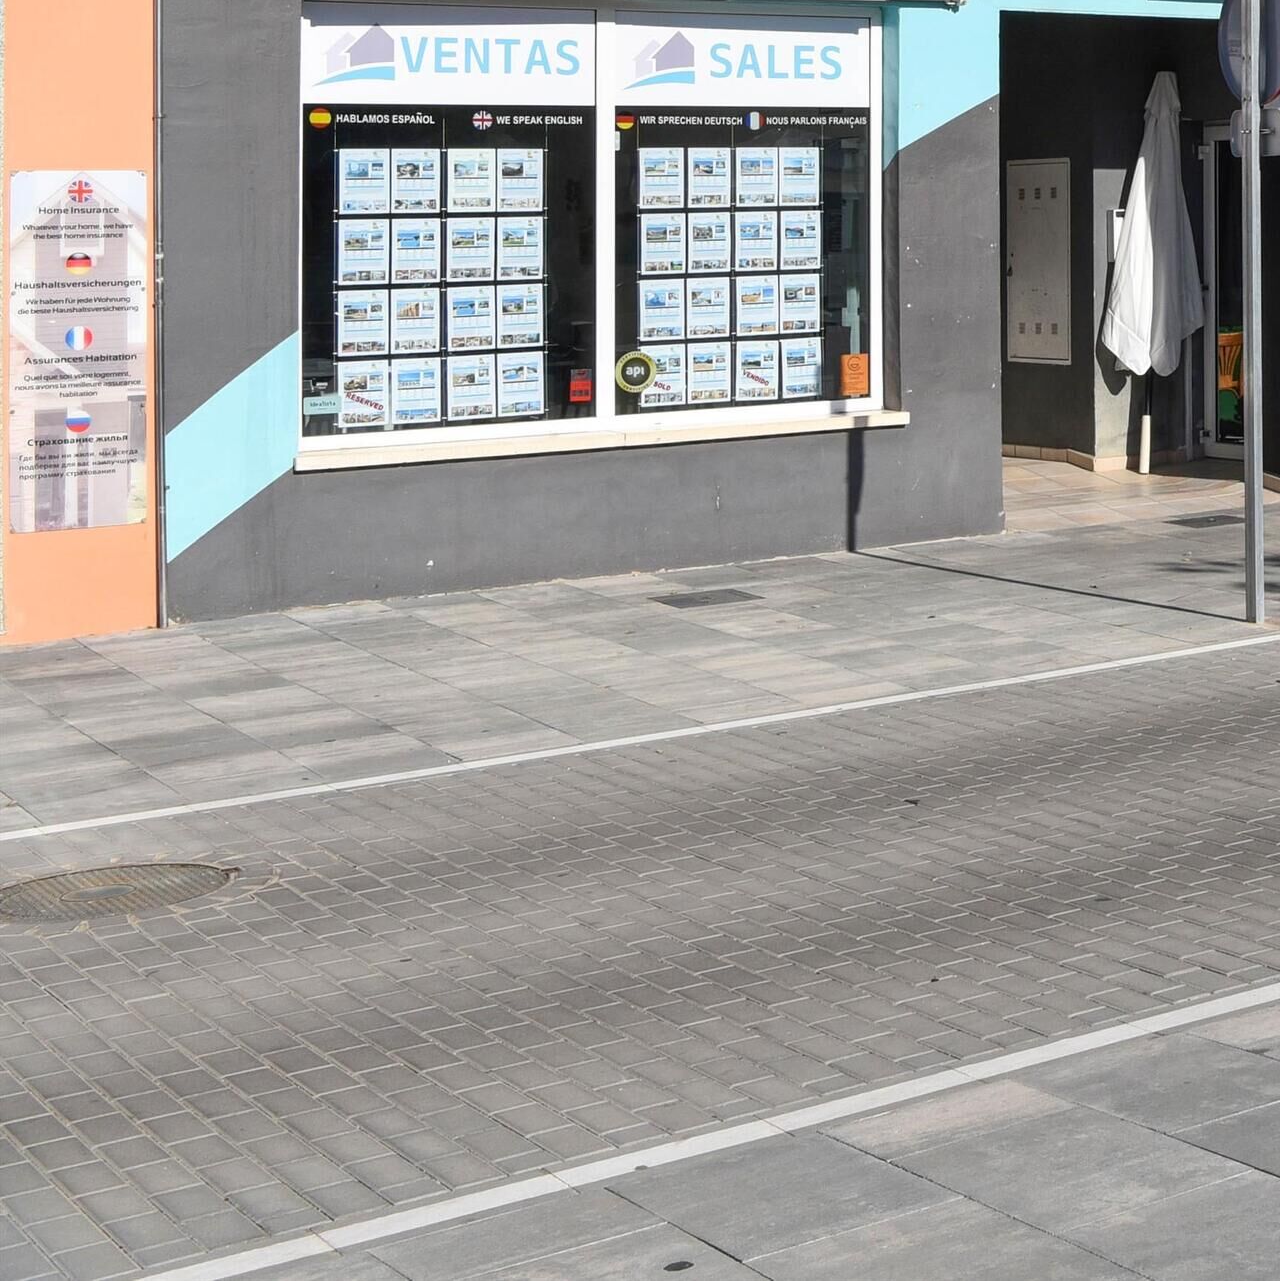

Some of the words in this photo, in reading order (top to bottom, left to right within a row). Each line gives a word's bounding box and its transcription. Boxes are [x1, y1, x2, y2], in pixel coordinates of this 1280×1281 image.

[400, 35, 581, 76] VENTAS
[709, 42, 844, 81] SALES
[336, 114, 390, 123] HABLAMOS
[392, 112, 435, 125] ESPAÑOL
[496, 116, 512, 125] WE
[512, 116, 543, 125] SPEAK
[545, 116, 582, 125] ENGLISH
[640, 116, 656, 125] WIR
[658, 116, 703, 125] SPRECHEN
[704, 117, 743, 125] DEUTSCH
[766, 117, 789, 125] NOUS
[790, 117, 827, 125] PARLONS
[828, 117, 867, 128] FRANÇAIS
[14, 279, 142, 290] Haushaltsversicherungen
[24, 355, 84, 365] Assurances
[85, 353, 137, 363] Habitation
[743, 370, 770, 386] VENDIDO
[653, 381, 672, 391] SOLD
[345, 391, 384, 411] RESERVED
[28, 436, 94, 448] Страхование
[95, 435, 128, 443] жилья
